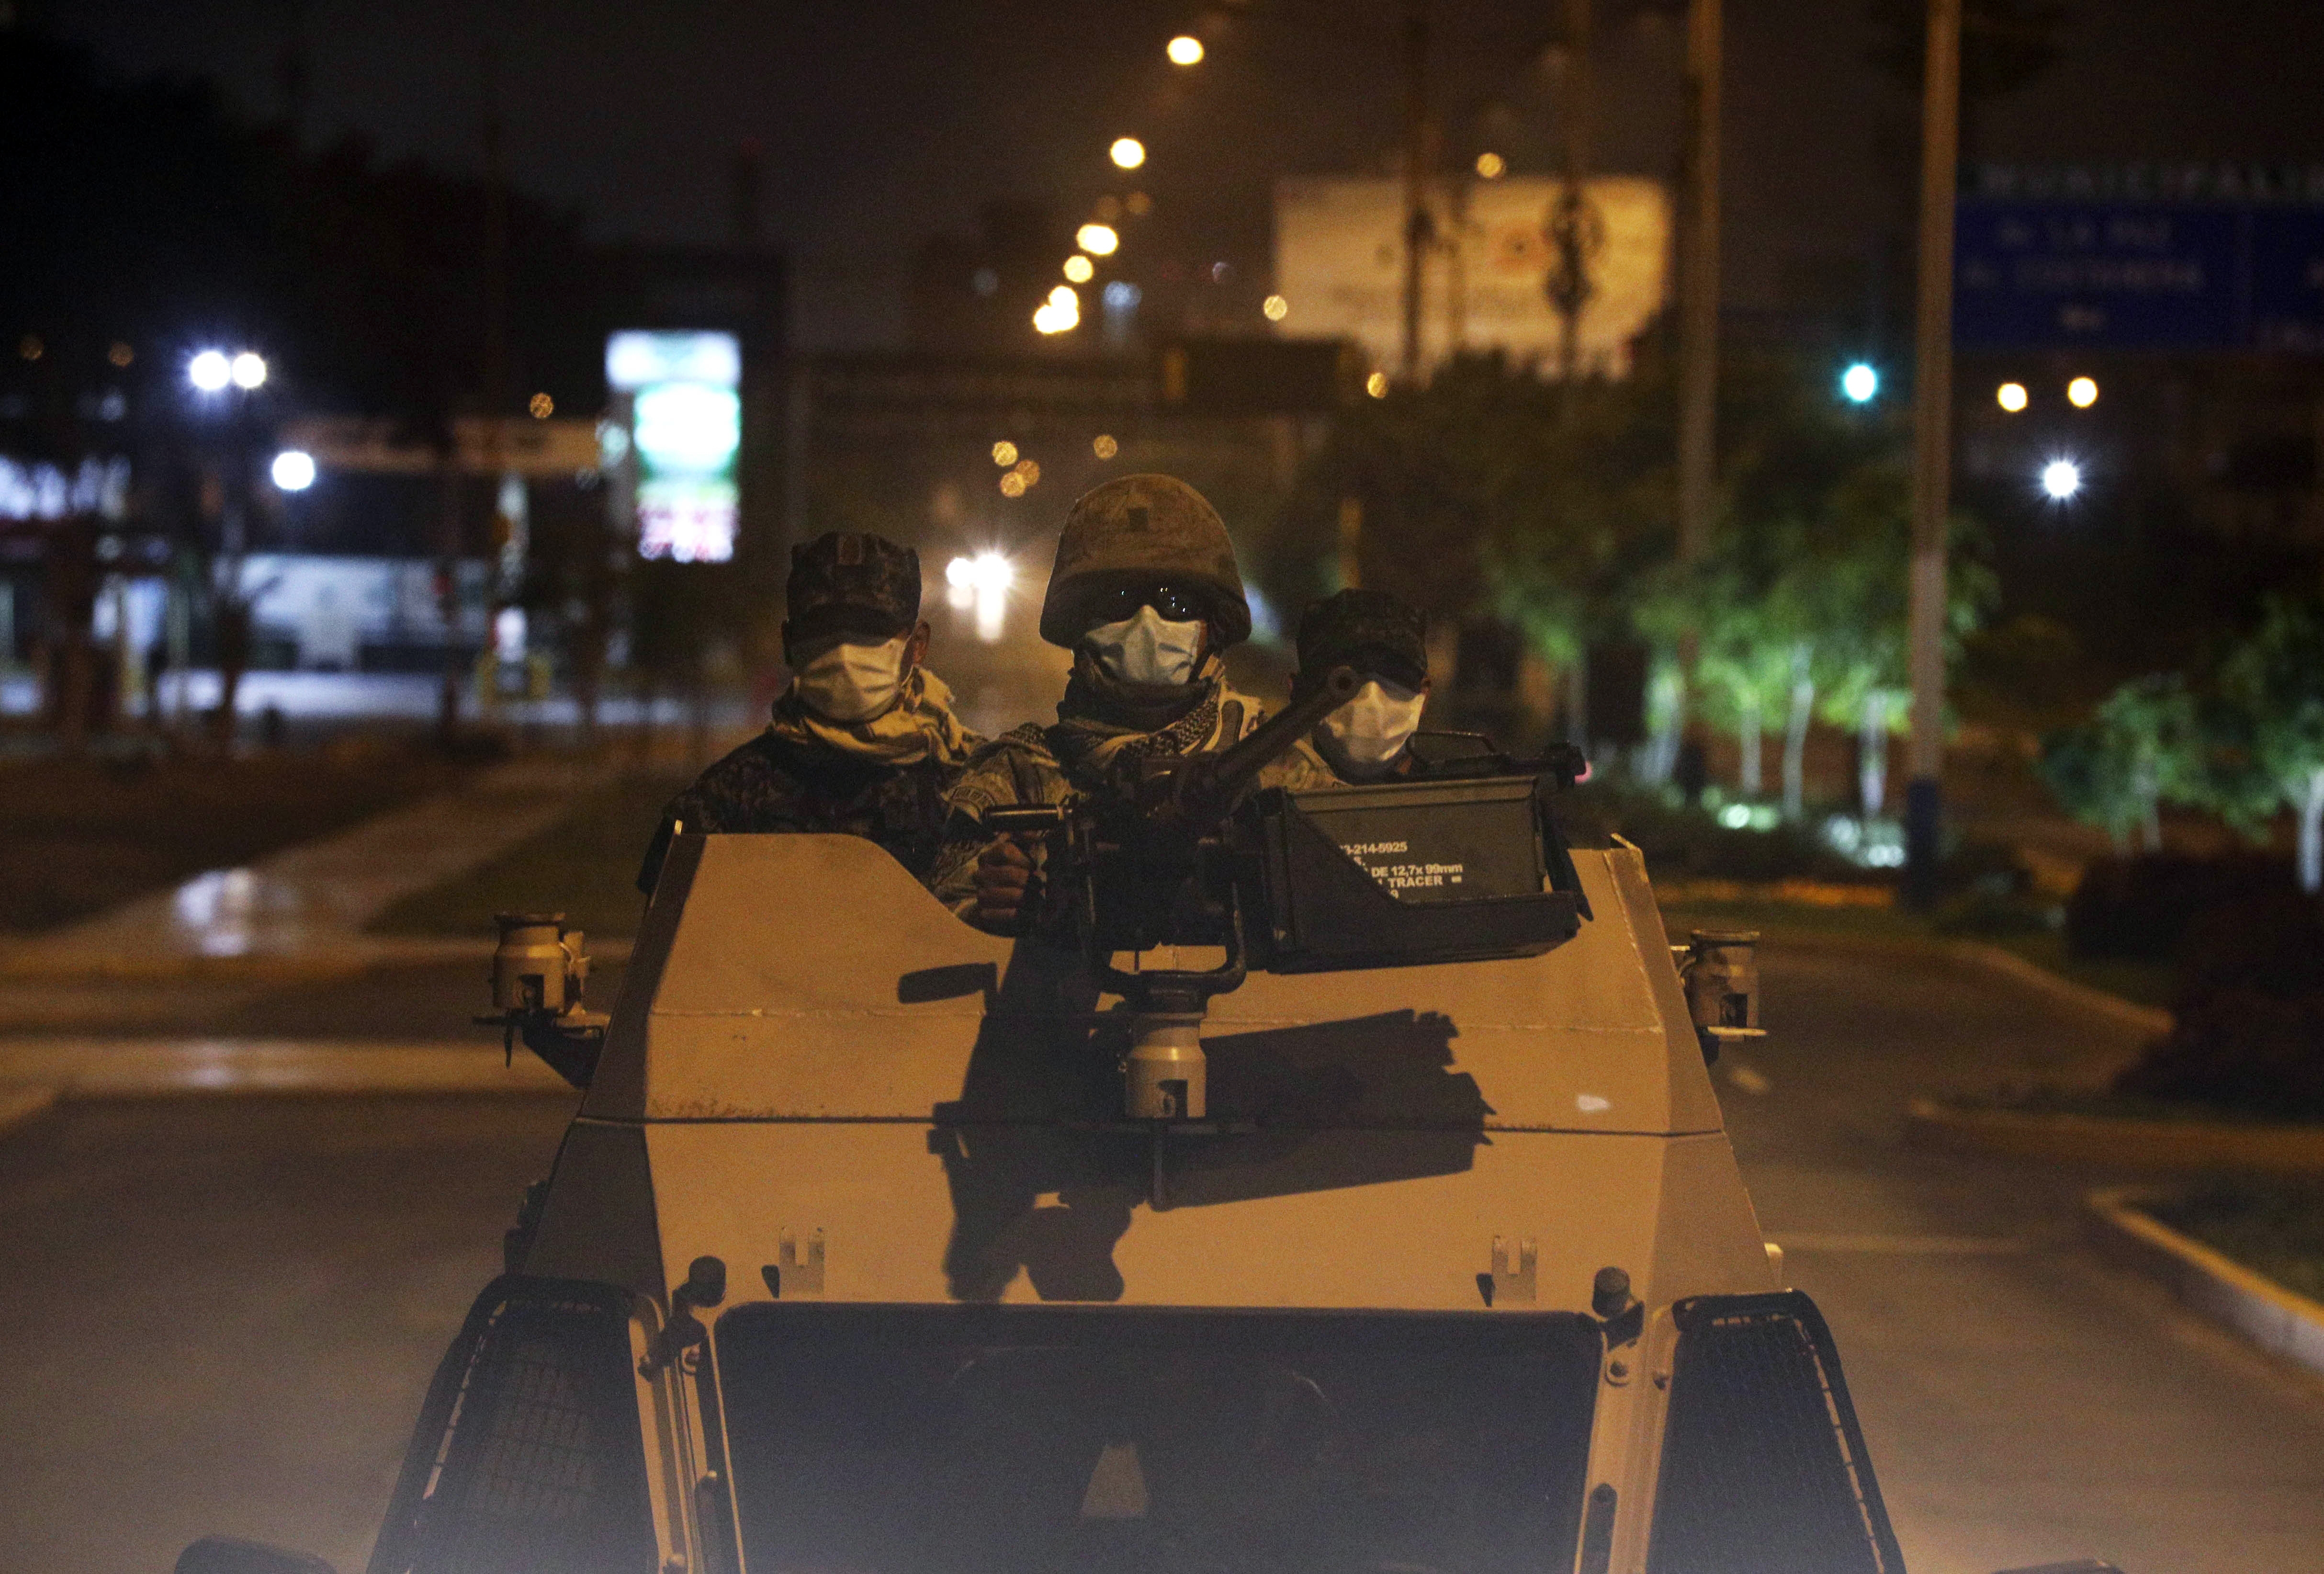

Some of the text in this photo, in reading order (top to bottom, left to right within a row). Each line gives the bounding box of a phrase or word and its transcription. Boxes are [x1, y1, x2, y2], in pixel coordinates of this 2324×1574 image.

[1371, 867, 1388, 878] DE
[1425, 863, 1463, 874] 99mm
[1388, 875, 1443, 887] TRACER
